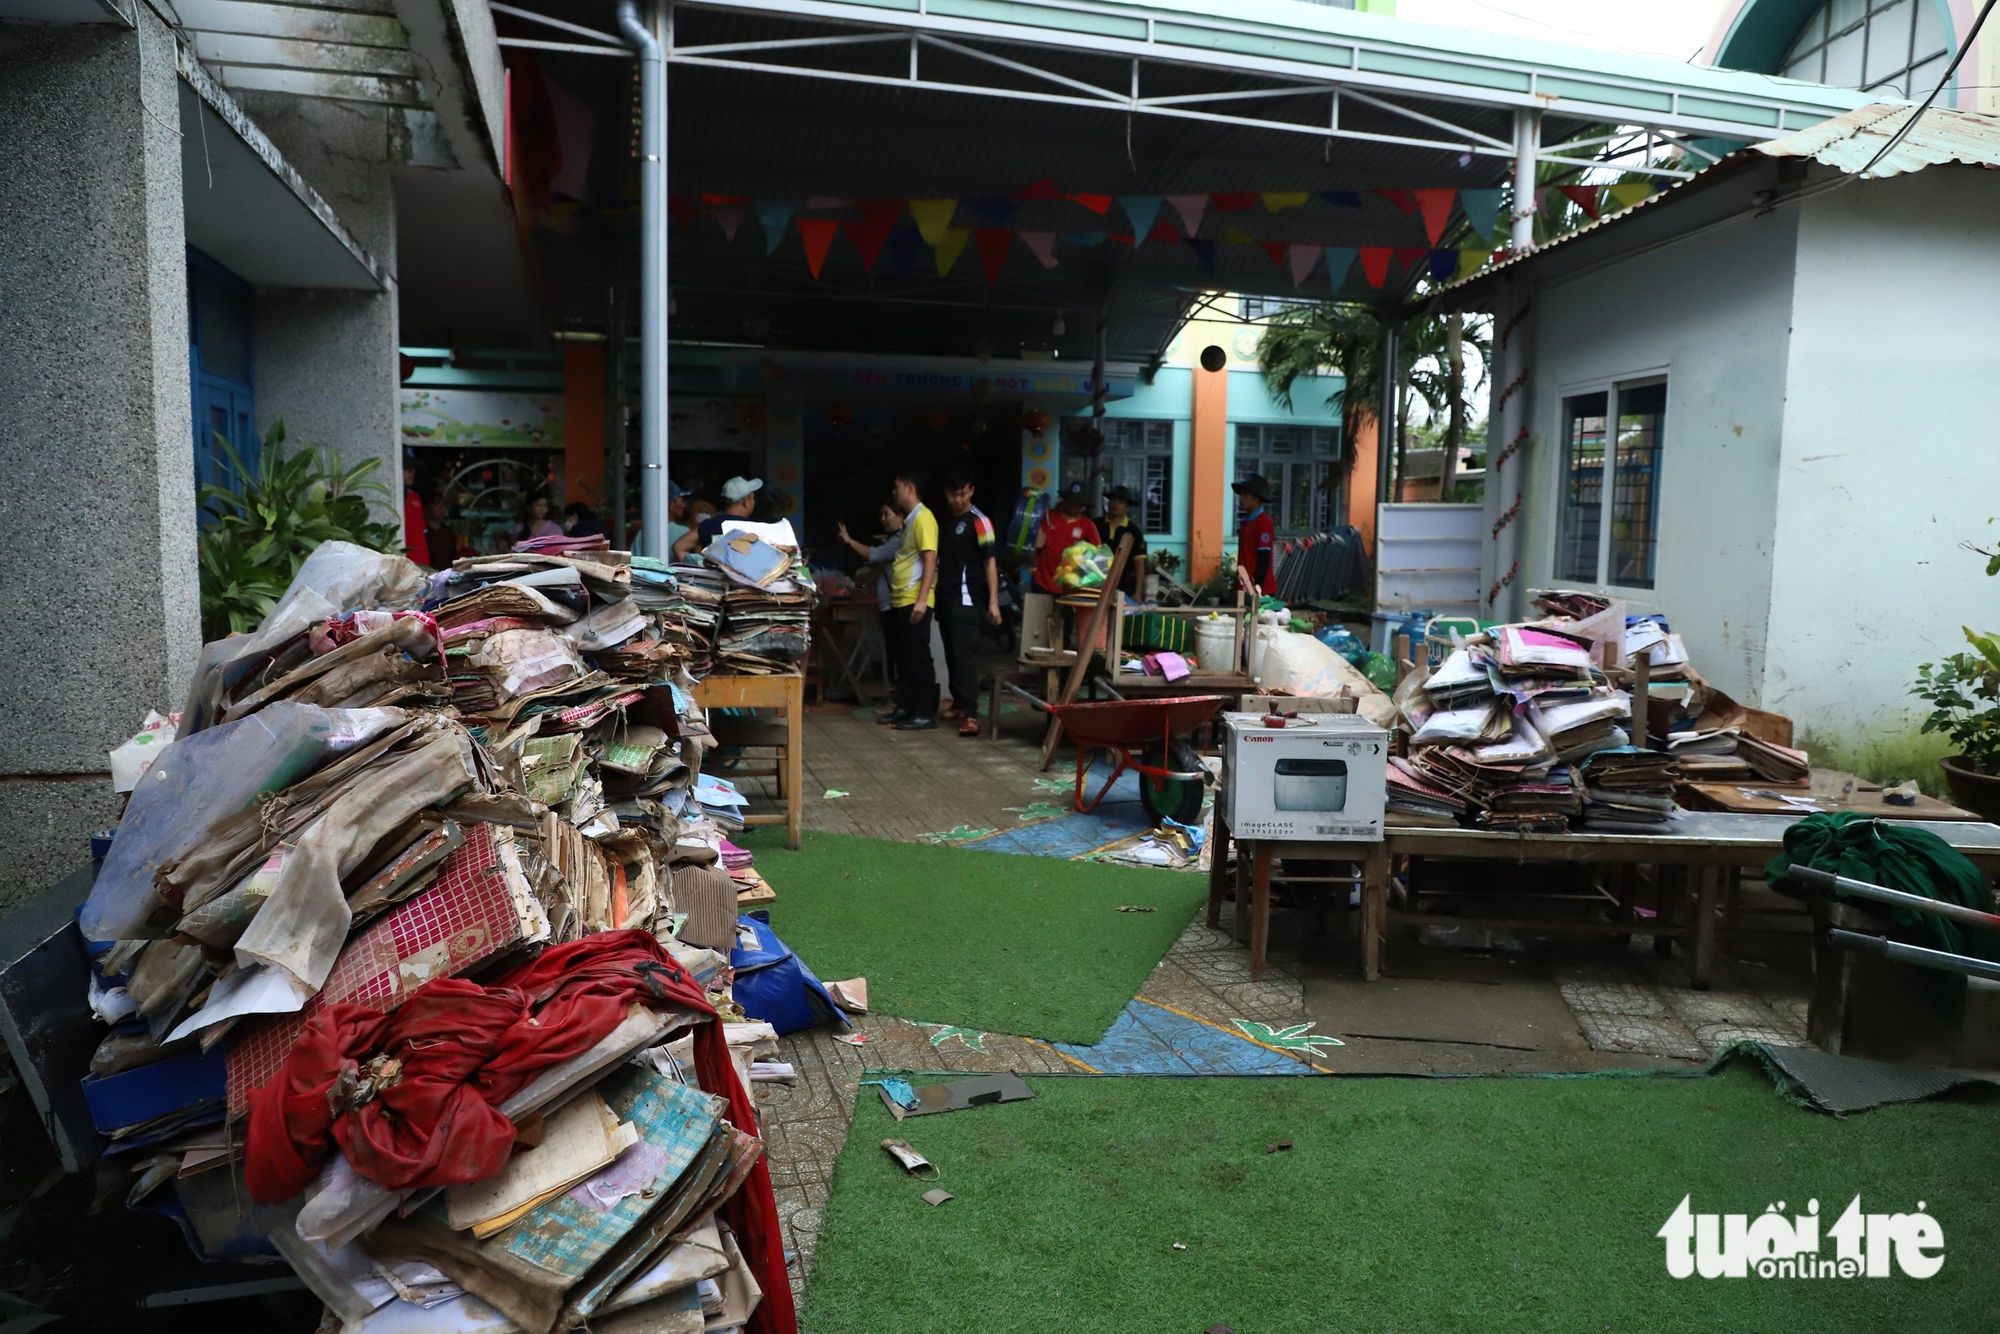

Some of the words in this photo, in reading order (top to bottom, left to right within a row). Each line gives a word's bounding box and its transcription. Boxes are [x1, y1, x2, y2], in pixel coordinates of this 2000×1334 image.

[996, 375, 1029, 390] MỘT
[1083, 381, 1110, 393] VI
[1243, 735, 1274, 743] Canon
